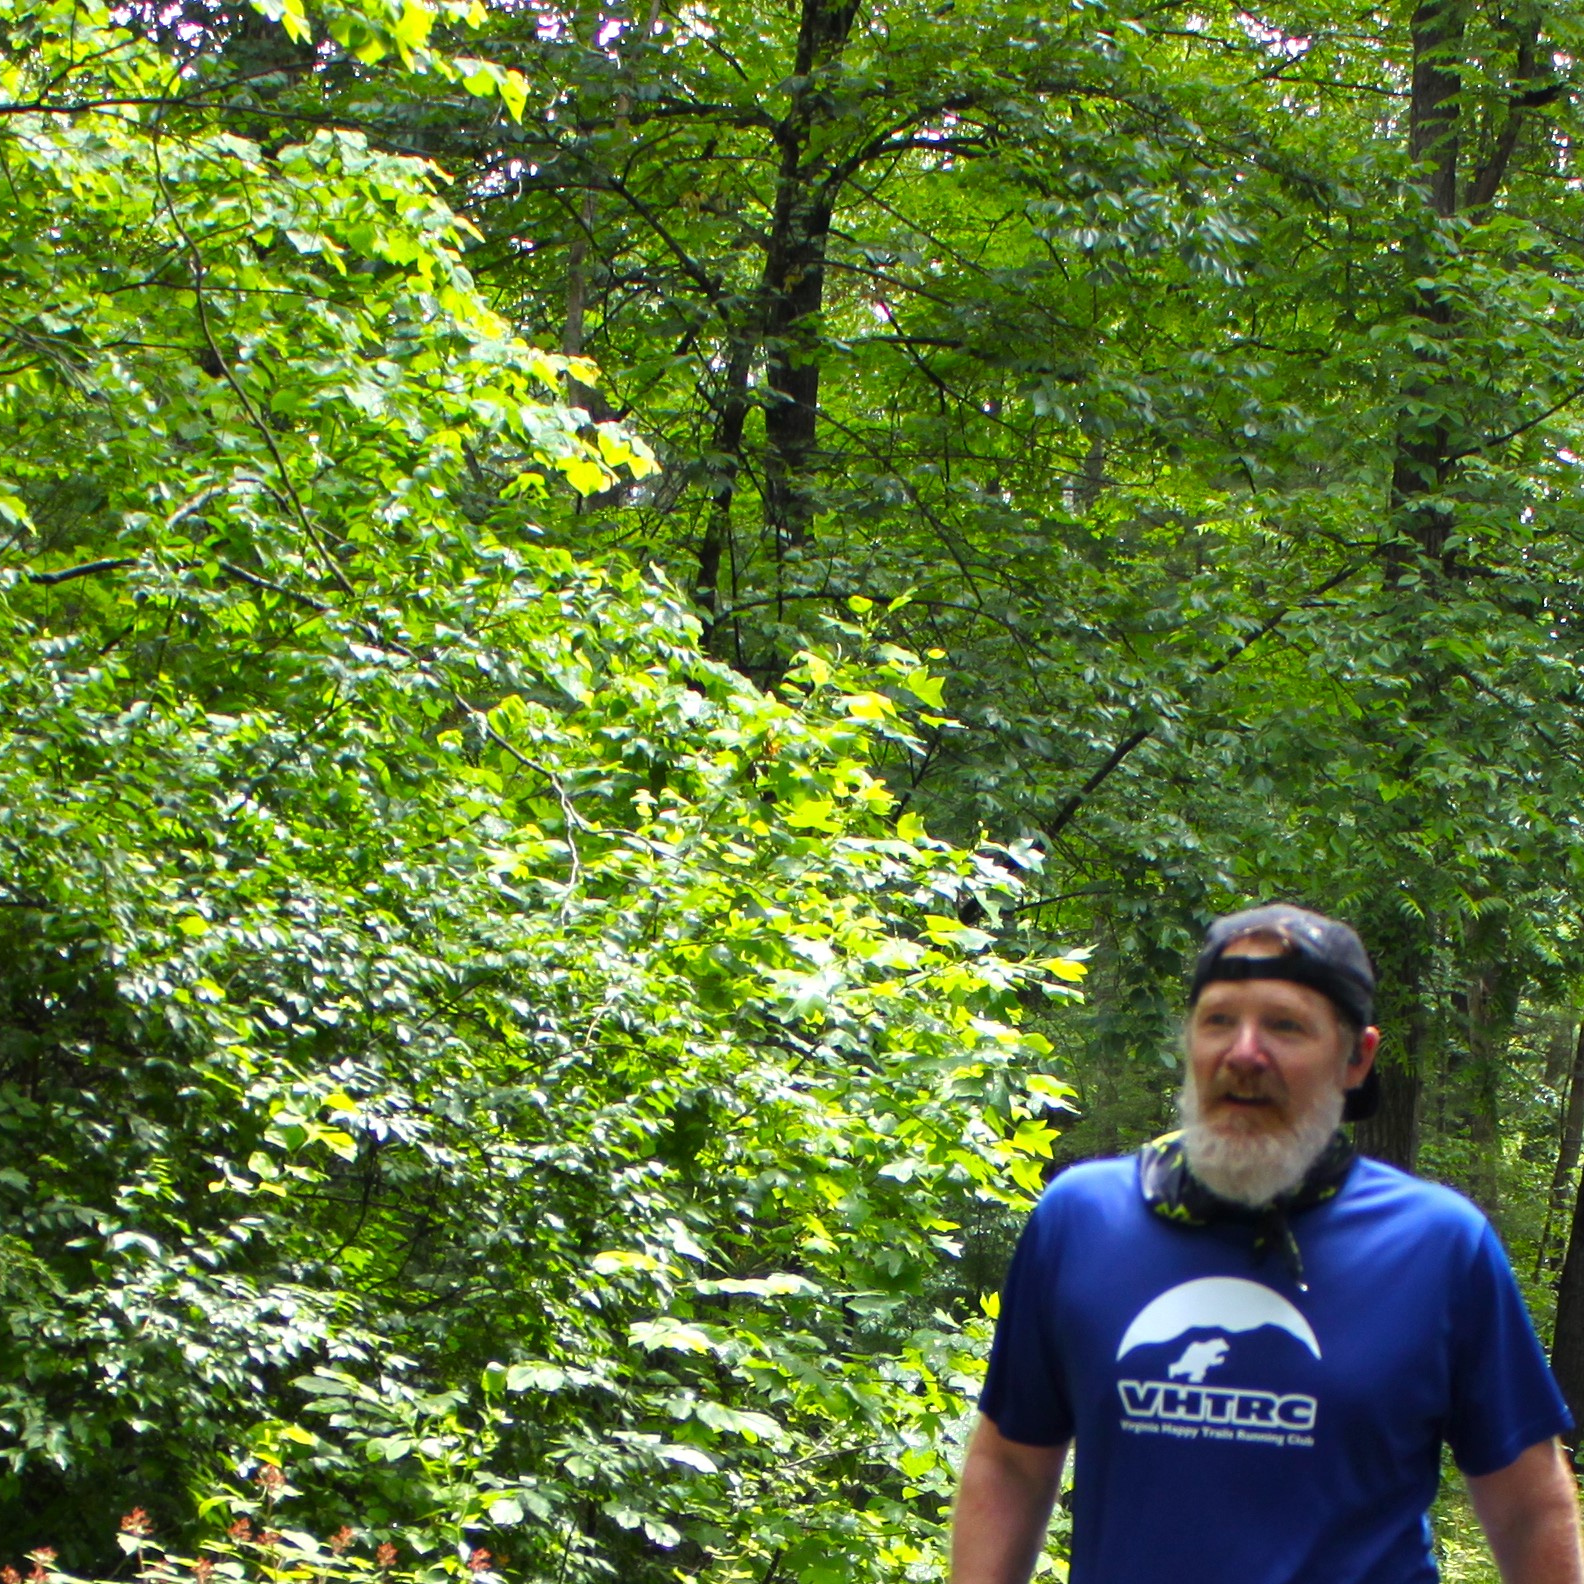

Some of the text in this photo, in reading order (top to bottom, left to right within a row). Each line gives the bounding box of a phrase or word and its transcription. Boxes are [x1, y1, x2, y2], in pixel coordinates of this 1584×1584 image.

[1118, 1380, 1317, 1431] VHTRC
[1120, 1419, 1315, 1447] Virginia Happy Trails Running Club
